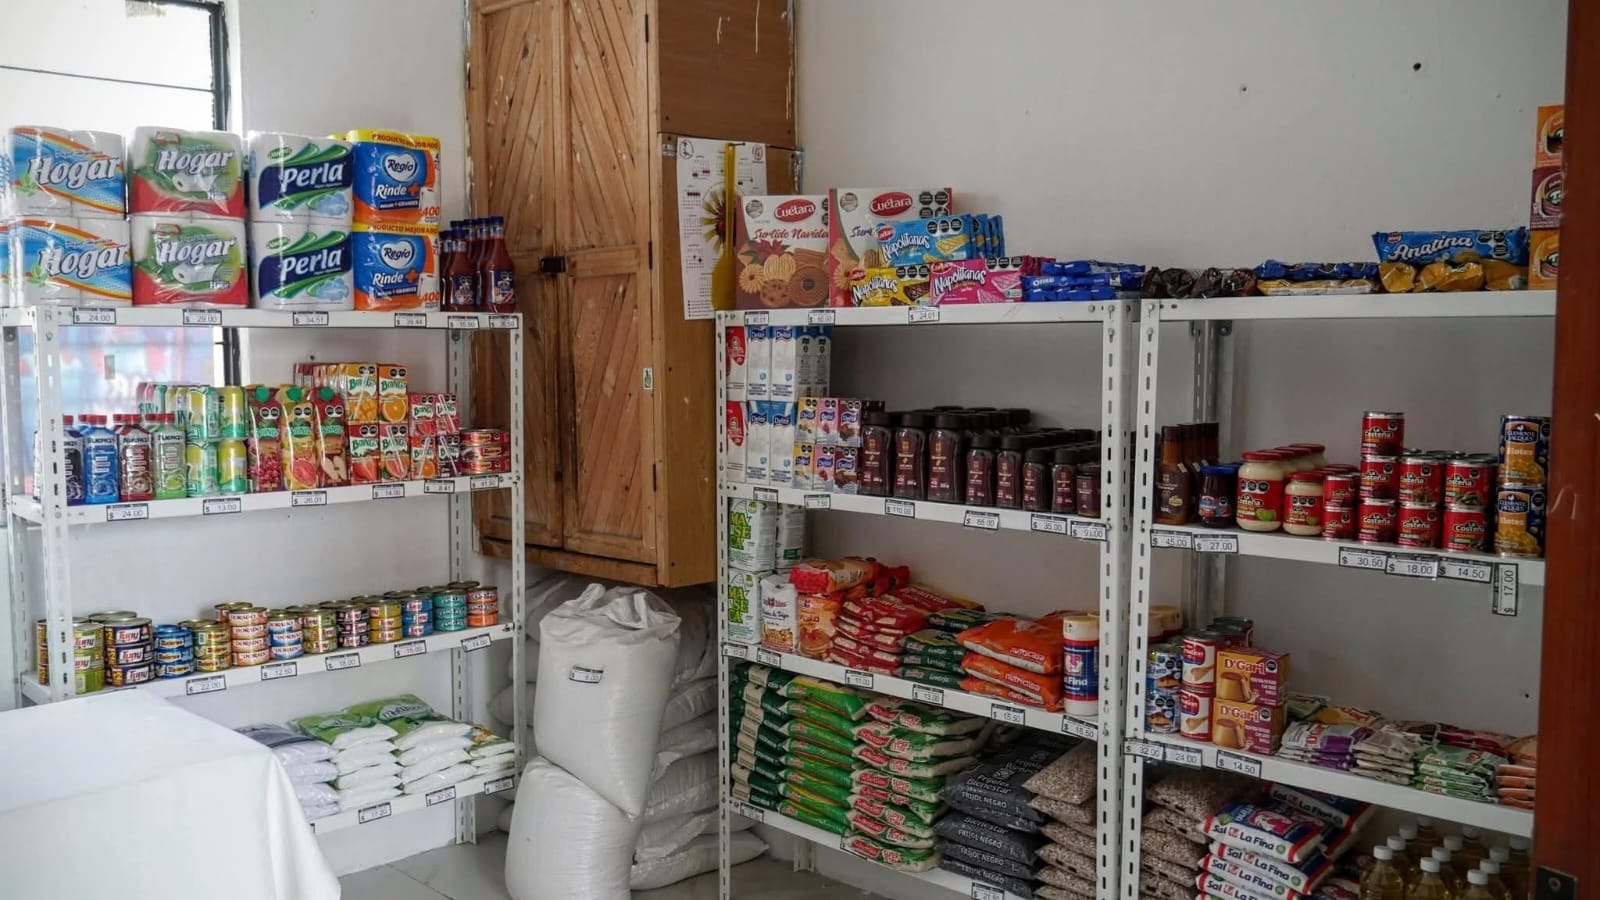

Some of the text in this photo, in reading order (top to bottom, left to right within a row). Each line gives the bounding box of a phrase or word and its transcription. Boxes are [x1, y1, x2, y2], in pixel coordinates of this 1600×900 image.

[157, 150, 233, 173] Hogar
[387, 158, 414, 173] Regio
[28, 157, 121, 190] Hogar
[282, 161, 344, 194] Perla
[375, 183, 408, 200] Rinde
[775, 202, 816, 219] Cuétara
[870, 196, 913, 214] Cuétara
[754, 227, 789, 240] Surtido
[157, 237, 237, 264] Hogar
[383, 247, 411, 261] Regio
[882, 232, 930, 262] Napolitanas
[1387, 235, 1474, 261] Anatina
[38, 243, 129, 279] Hogar
[279, 248, 343, 283] Perla
[372, 271, 404, 288] Rinde
[934, 266, 987, 297] Napolitanas
[852, 276, 899, 305] Napolitanas
[89, 313, 111, 322] 24.00
[121, 509, 143, 519] 24.00
[218, 502, 237, 511] 13.00
[976, 518, 996, 528] 66.00
[1165, 536, 1187, 547] 45.00
[1210, 541, 1233, 551] 27.00
[1357, 556, 1384, 568] 30.50
[1406, 563, 1433, 575] 18.00
[1457, 566, 1485, 580] 14.50
[1503, 569, 1514, 597] 17.00
[74, 637, 95, 649] Tuny
[119, 630, 139, 643] Tuny
[74, 659, 89, 669] uny
[122, 650, 142, 663] Tuny
[1224, 658, 1265, 675] D'Gari
[129, 671, 148, 683] Tuny
[1068, 676, 1088, 686] Fina
[1003, 711, 1021, 723] 15.50
[1220, 705, 1260, 723] D'Gari
[1138, 745, 1160, 758] 32.00
[1174, 751, 1197, 764] 24.00
[1232, 760, 1256, 775] 14.50
[961, 791, 1007, 809] FRIJOL NEGRO
[958, 828, 1003, 849] FRIJOL NEGRO
[1212, 824, 1275, 851] Sal La Fina
[982, 853, 1005, 867] NEGRO
[1226, 847, 1290, 882] Sal La Fina
[1211, 858, 1274, 891] Sal La Fina
[1207, 879, 1223, 892] Sal
